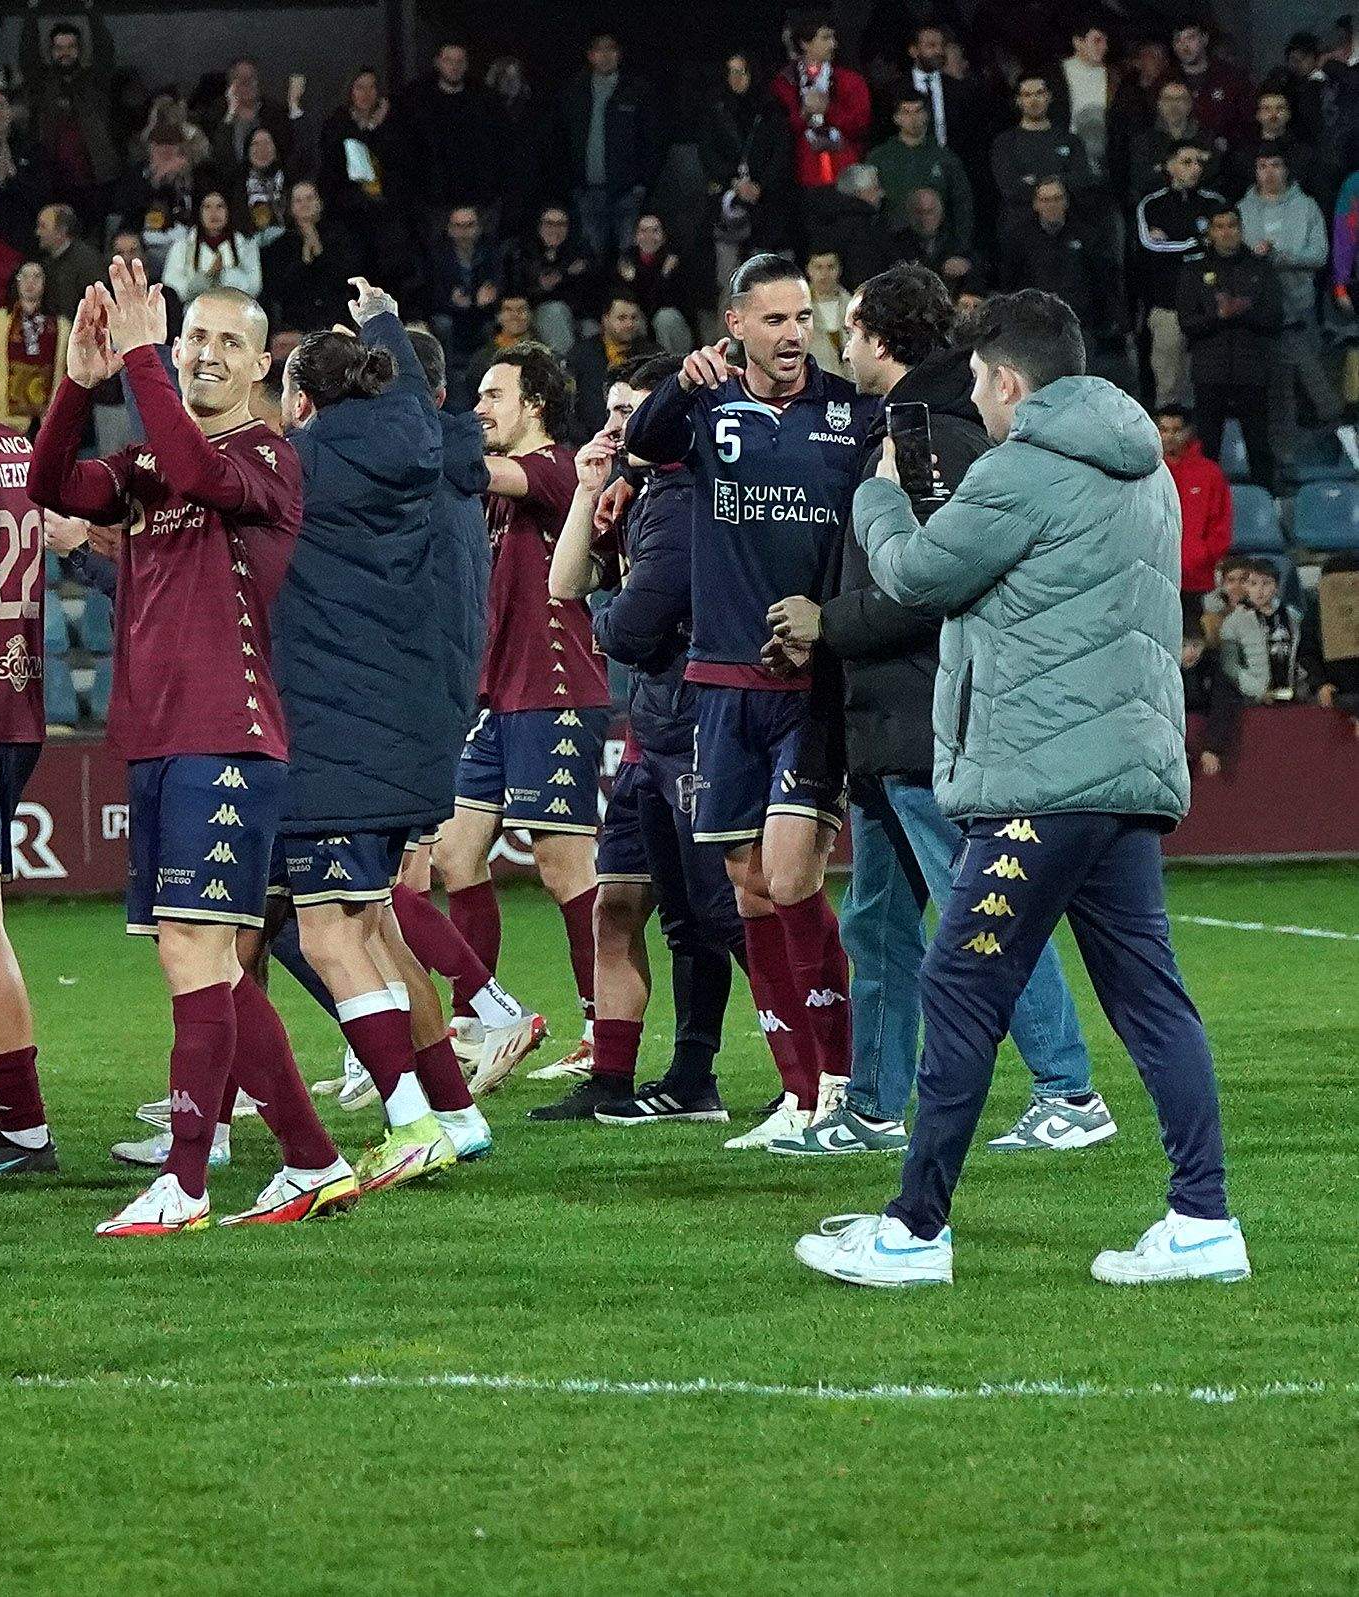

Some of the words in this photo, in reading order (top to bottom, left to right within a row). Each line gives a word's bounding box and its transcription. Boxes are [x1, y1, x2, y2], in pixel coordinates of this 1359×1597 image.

[715, 418, 741, 463] 5
[743, 486, 807, 503] XUNTA
[743, 505, 766, 521] DE
[771, 506, 840, 526] GALICIA
